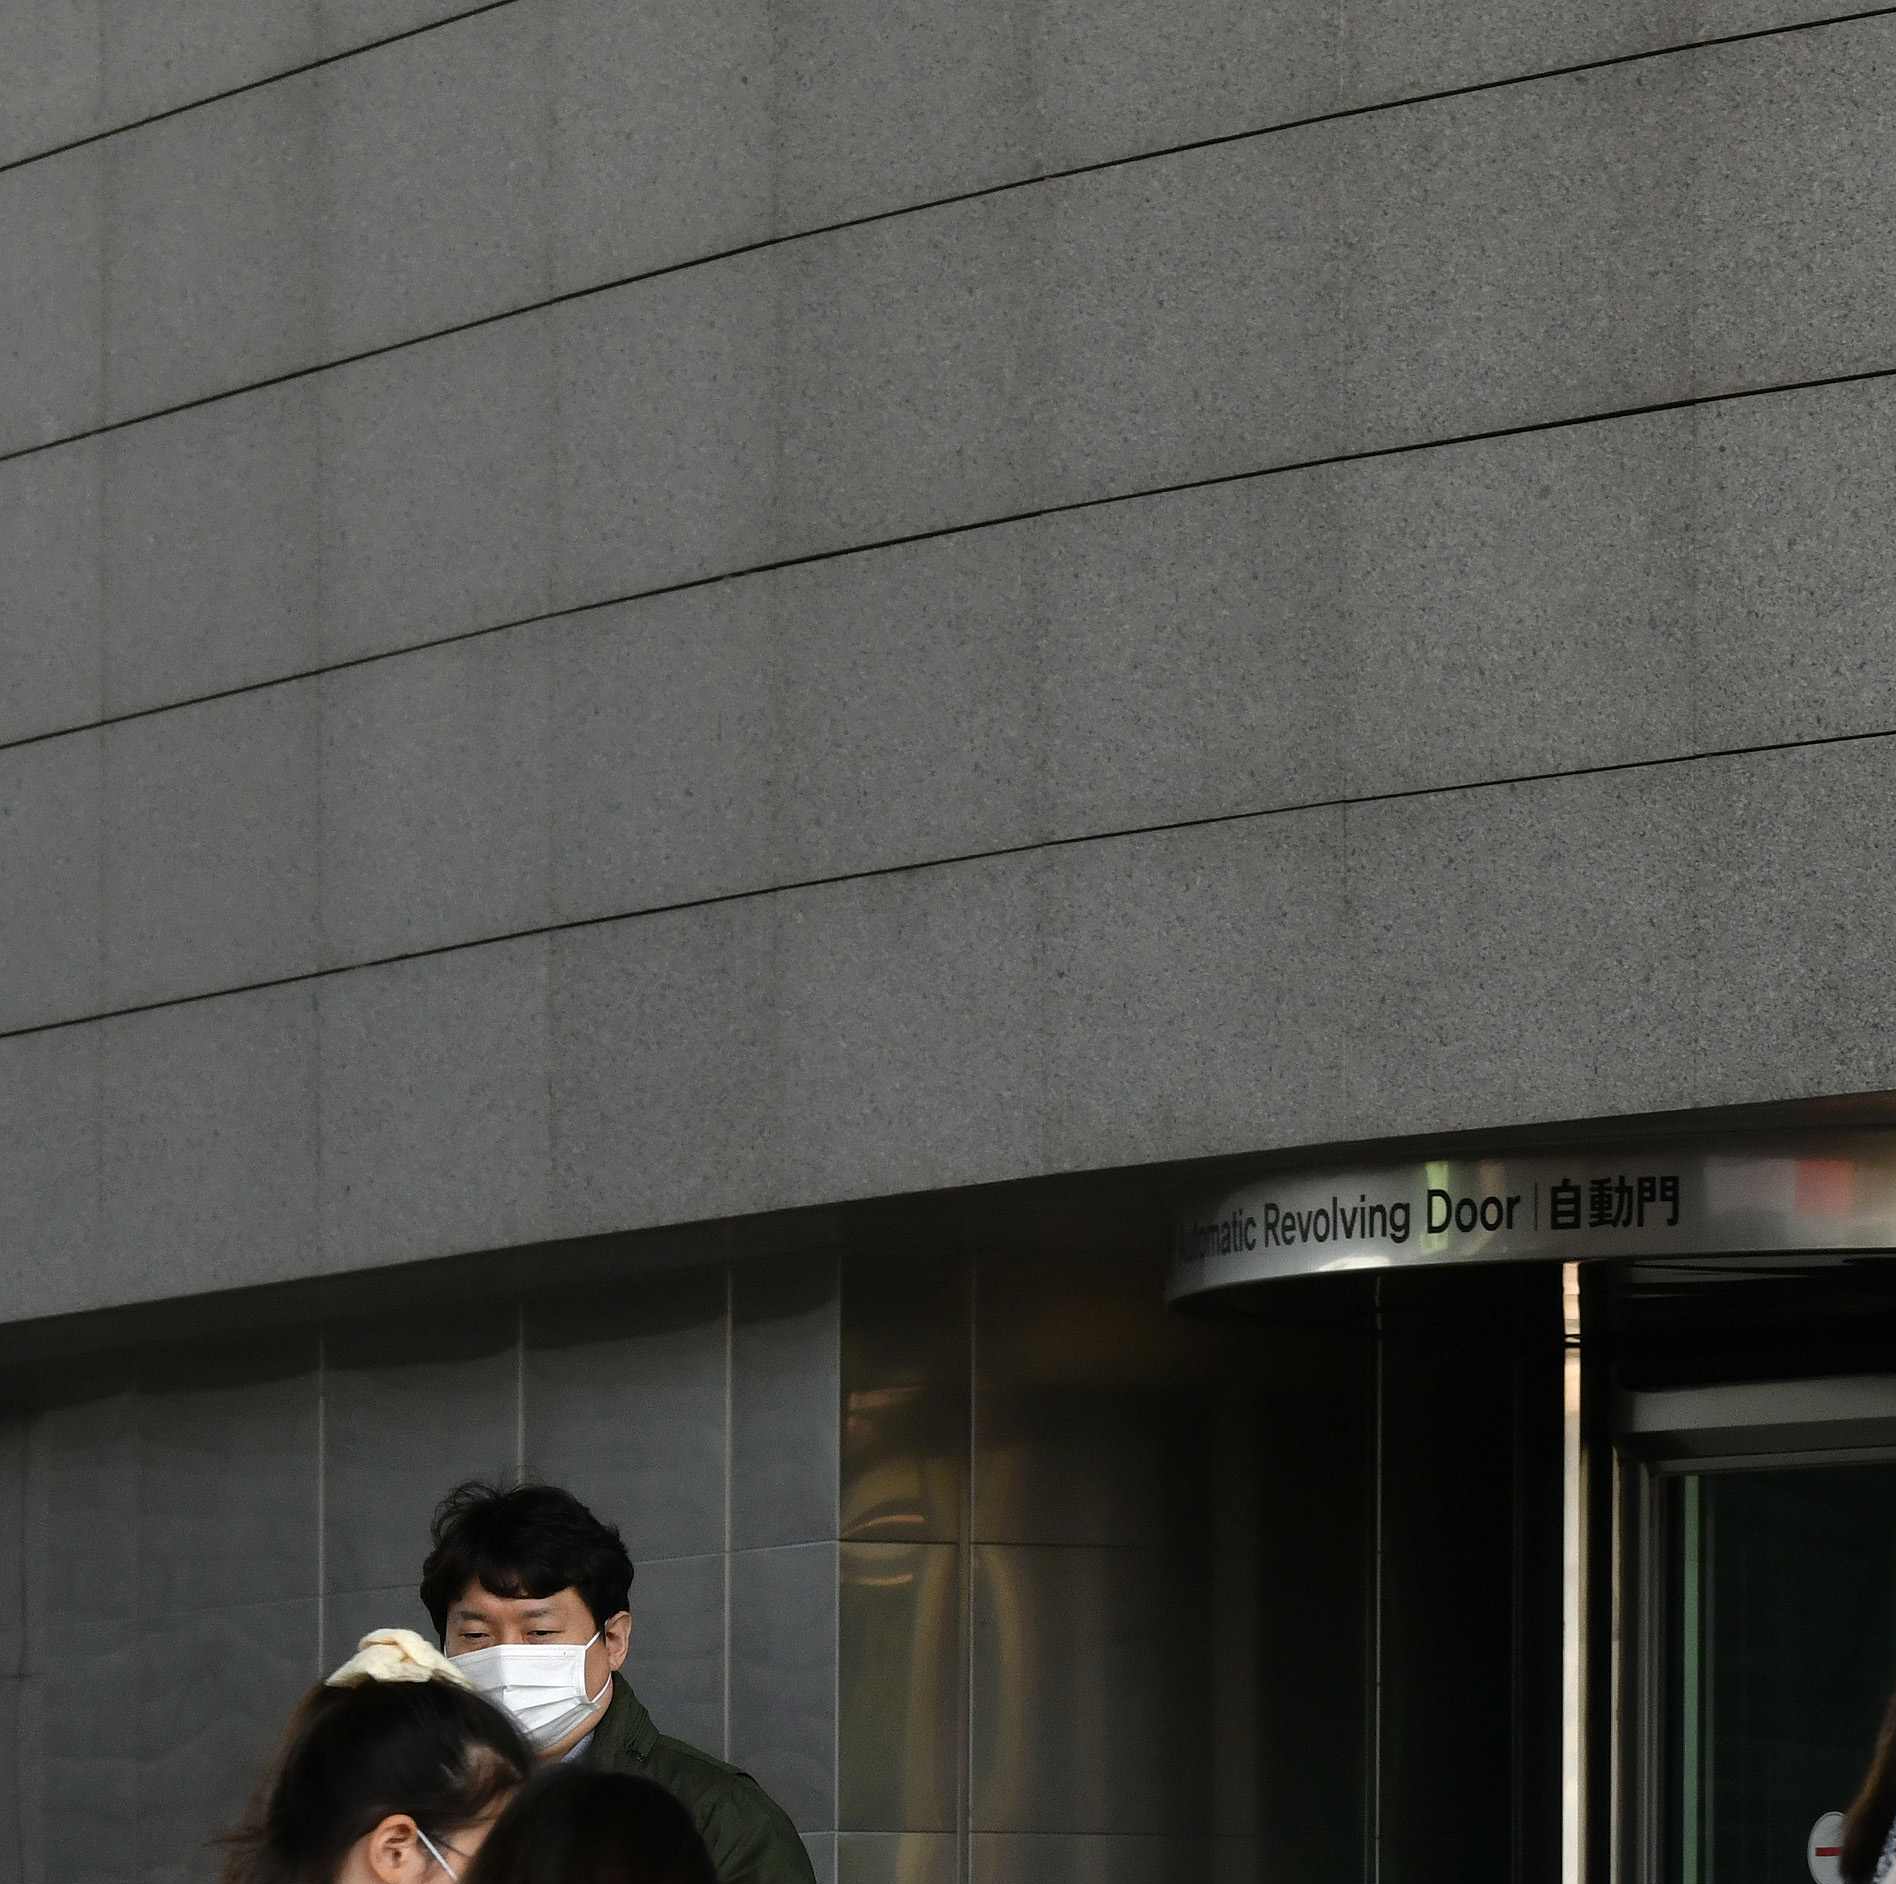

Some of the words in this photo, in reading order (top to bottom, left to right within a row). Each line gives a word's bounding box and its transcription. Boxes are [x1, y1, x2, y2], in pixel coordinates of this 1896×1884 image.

[1264, 1194, 1411, 1248] Revolving
[1426, 1188, 1521, 1235] Door
[1549, 1175, 1681, 1231] 自動門
